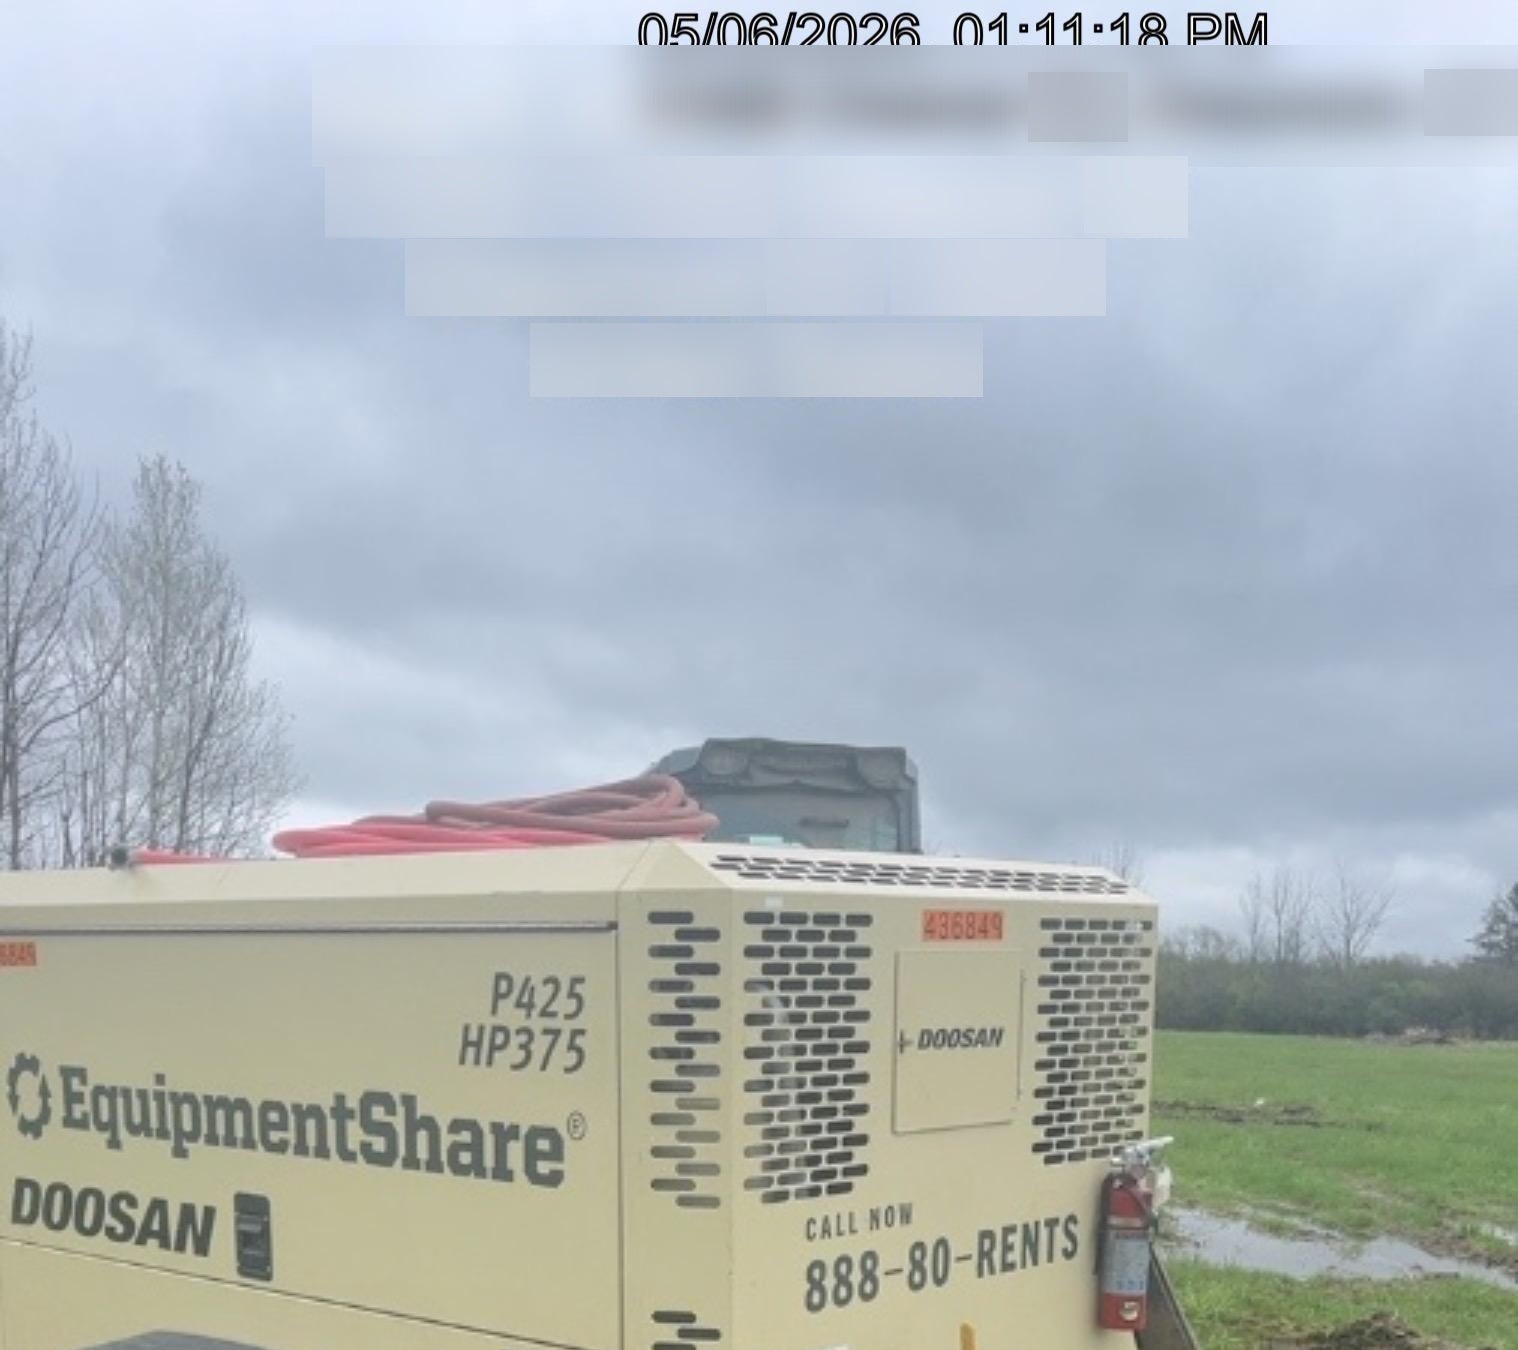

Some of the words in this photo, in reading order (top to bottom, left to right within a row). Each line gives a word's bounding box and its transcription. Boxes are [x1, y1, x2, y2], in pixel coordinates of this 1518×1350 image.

[923, 911, 1003, 940] 436849
[491, 971, 586, 1021] P425
[458, 1022, 587, 1075] HP375
[917, 1027, 1005, 1051] DOOSAN
[11, 1177, 217, 1258] DOOSAN
[805, 1211, 859, 1242] CALL
[869, 1202, 912, 1231] NOW
[804, 1213, 1080, 1314] 888-80-RENTS
